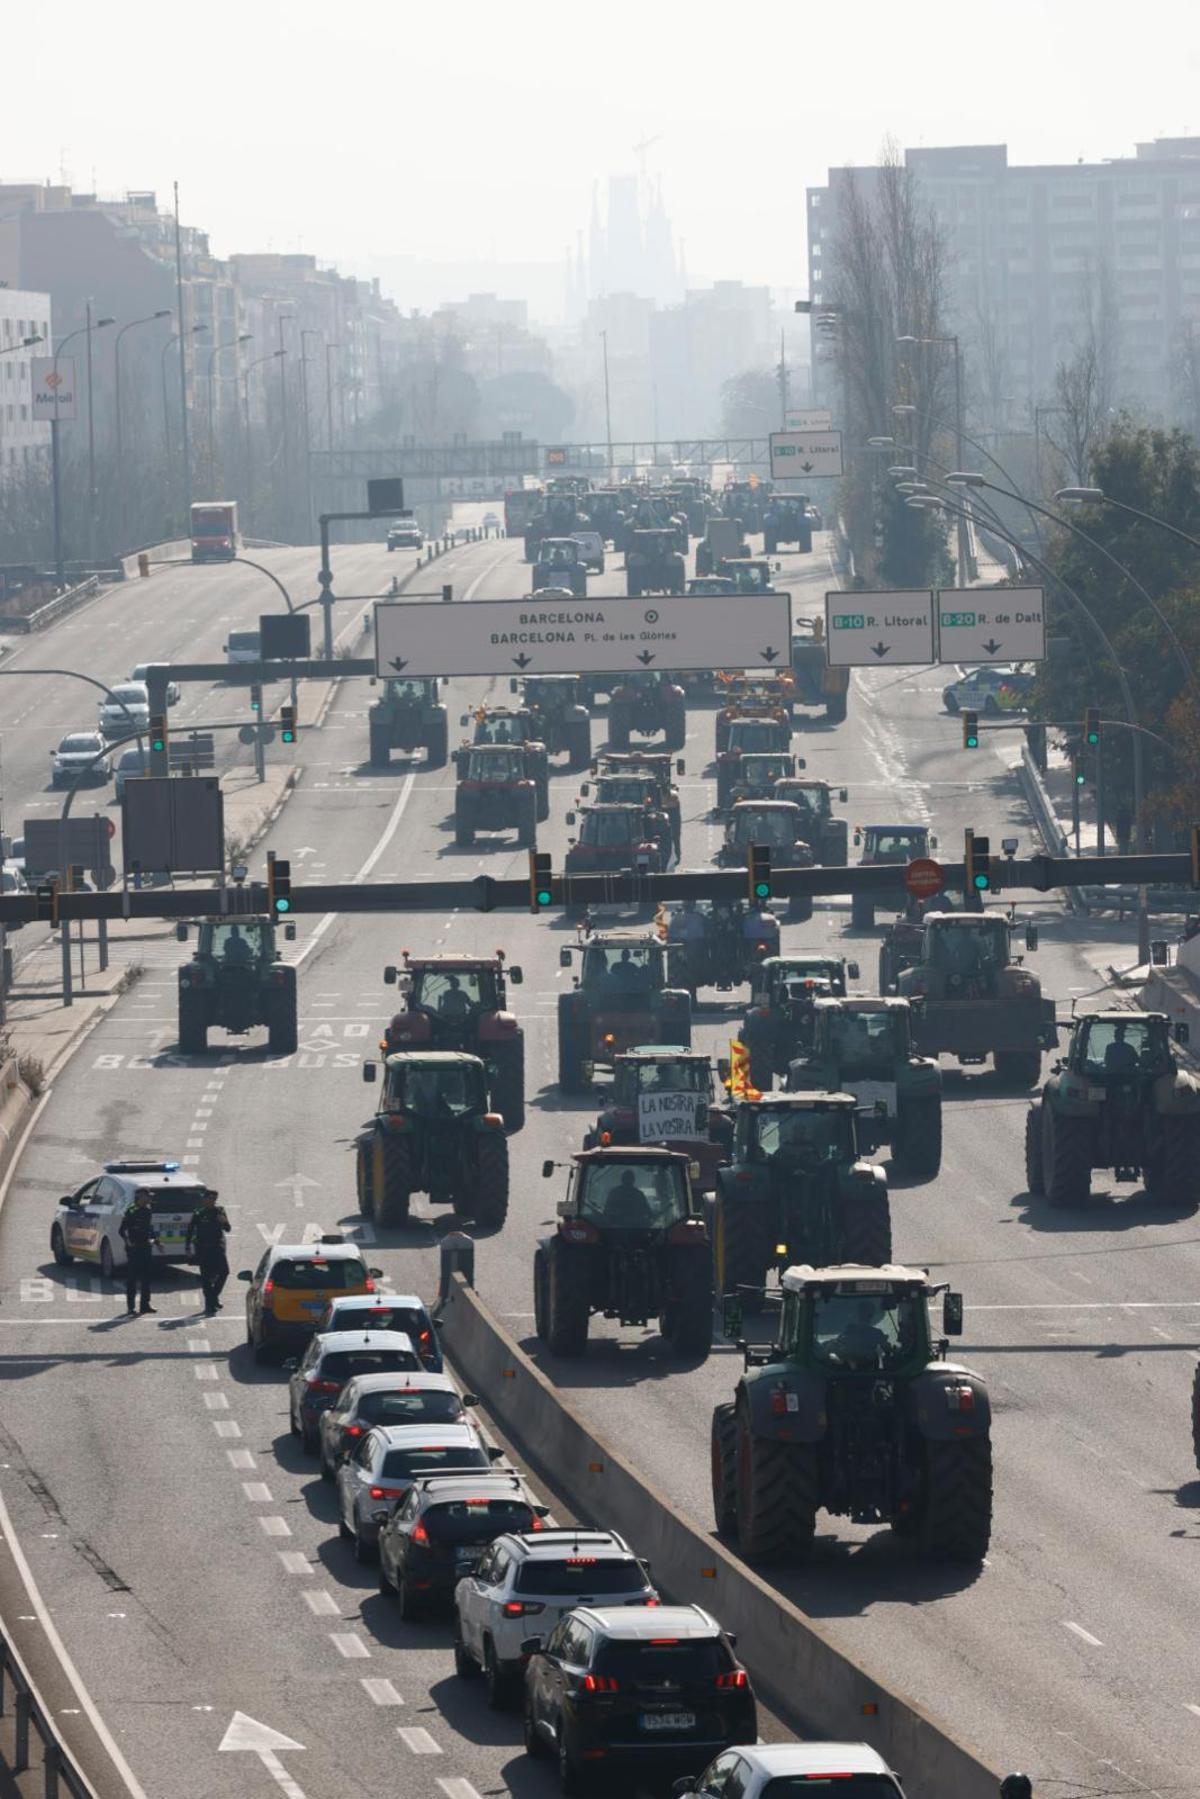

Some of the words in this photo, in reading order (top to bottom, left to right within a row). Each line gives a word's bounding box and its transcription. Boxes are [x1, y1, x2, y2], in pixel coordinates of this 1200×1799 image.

[36, 392, 73, 403] Meoil
[519, 612, 605, 624] BARCELONA
[834, 616, 863, 627] B-10
[867, 617, 879, 627] R.
[884, 615, 928, 627] Litoral
[943, 613, 974, 625] B-20
[978, 614, 990, 624] R.
[995, 613, 1010, 623] de
[1015, 612, 1041, 623] Dalt
[490, 631, 575, 644] BARCELONA
[603, 631, 615, 641] de
[620, 631, 635, 641] les
[262, 1053, 361, 1069] BUS
[642, 1098, 656, 1113] LA
[642, 1121, 655, 1137] LA
